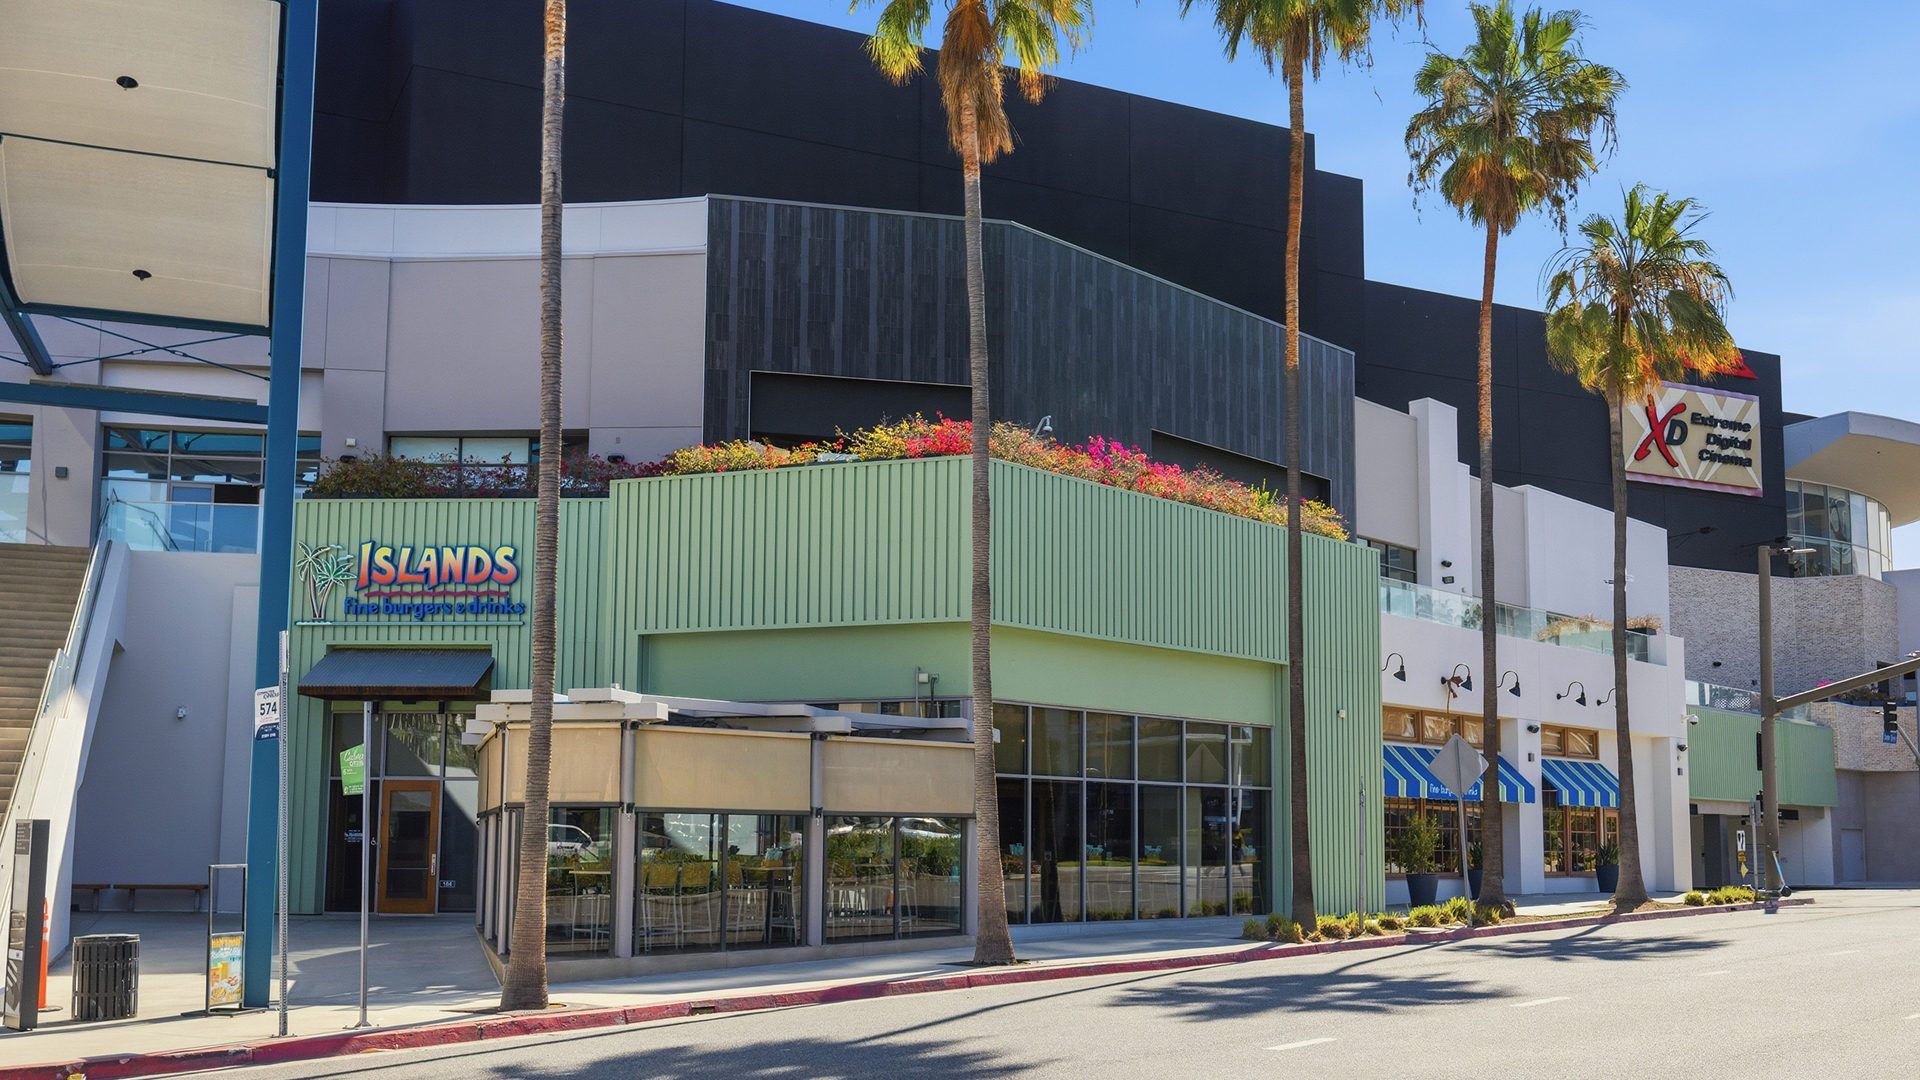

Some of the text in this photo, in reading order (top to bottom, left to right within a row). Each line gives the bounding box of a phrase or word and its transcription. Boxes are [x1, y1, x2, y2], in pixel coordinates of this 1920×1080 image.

[1634, 394, 1689, 468] XD
[1690, 412, 1752, 433] Extreme
[1706, 433, 1753, 451] Digital
[1698, 448, 1753, 468] Cinema
[354, 540, 519, 591] ISLANDS
[344, 596, 525, 621] fine burgers & drinks
[260, 701, 277, 716] 574
